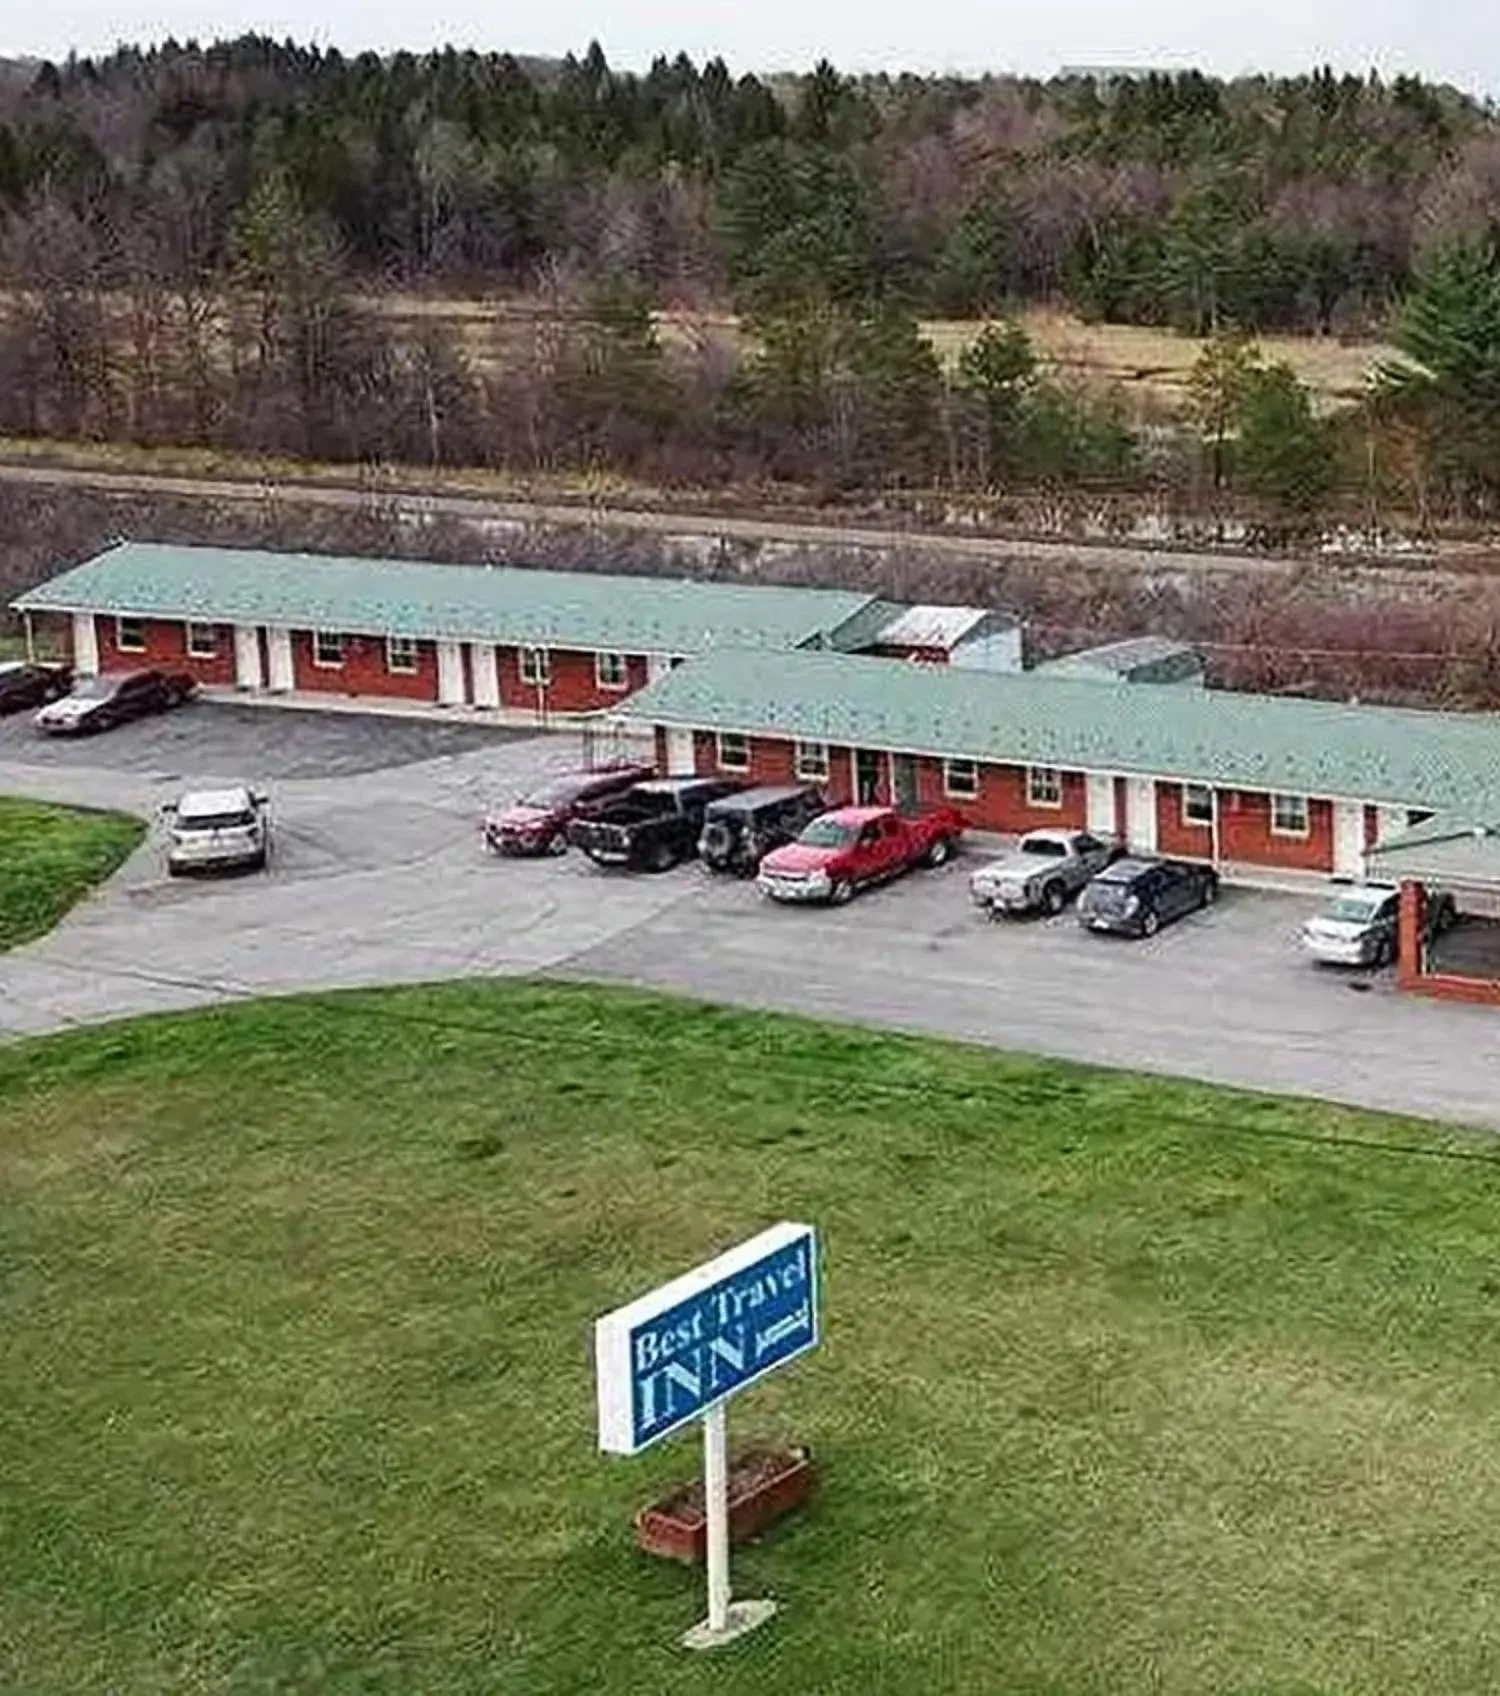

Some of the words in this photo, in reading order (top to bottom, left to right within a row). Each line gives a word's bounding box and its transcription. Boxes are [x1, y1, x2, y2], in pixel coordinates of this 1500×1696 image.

[637, 1309, 702, 1371] Best
[711, 1249, 806, 1324] Travel
[638, 1323, 746, 1431] INN
